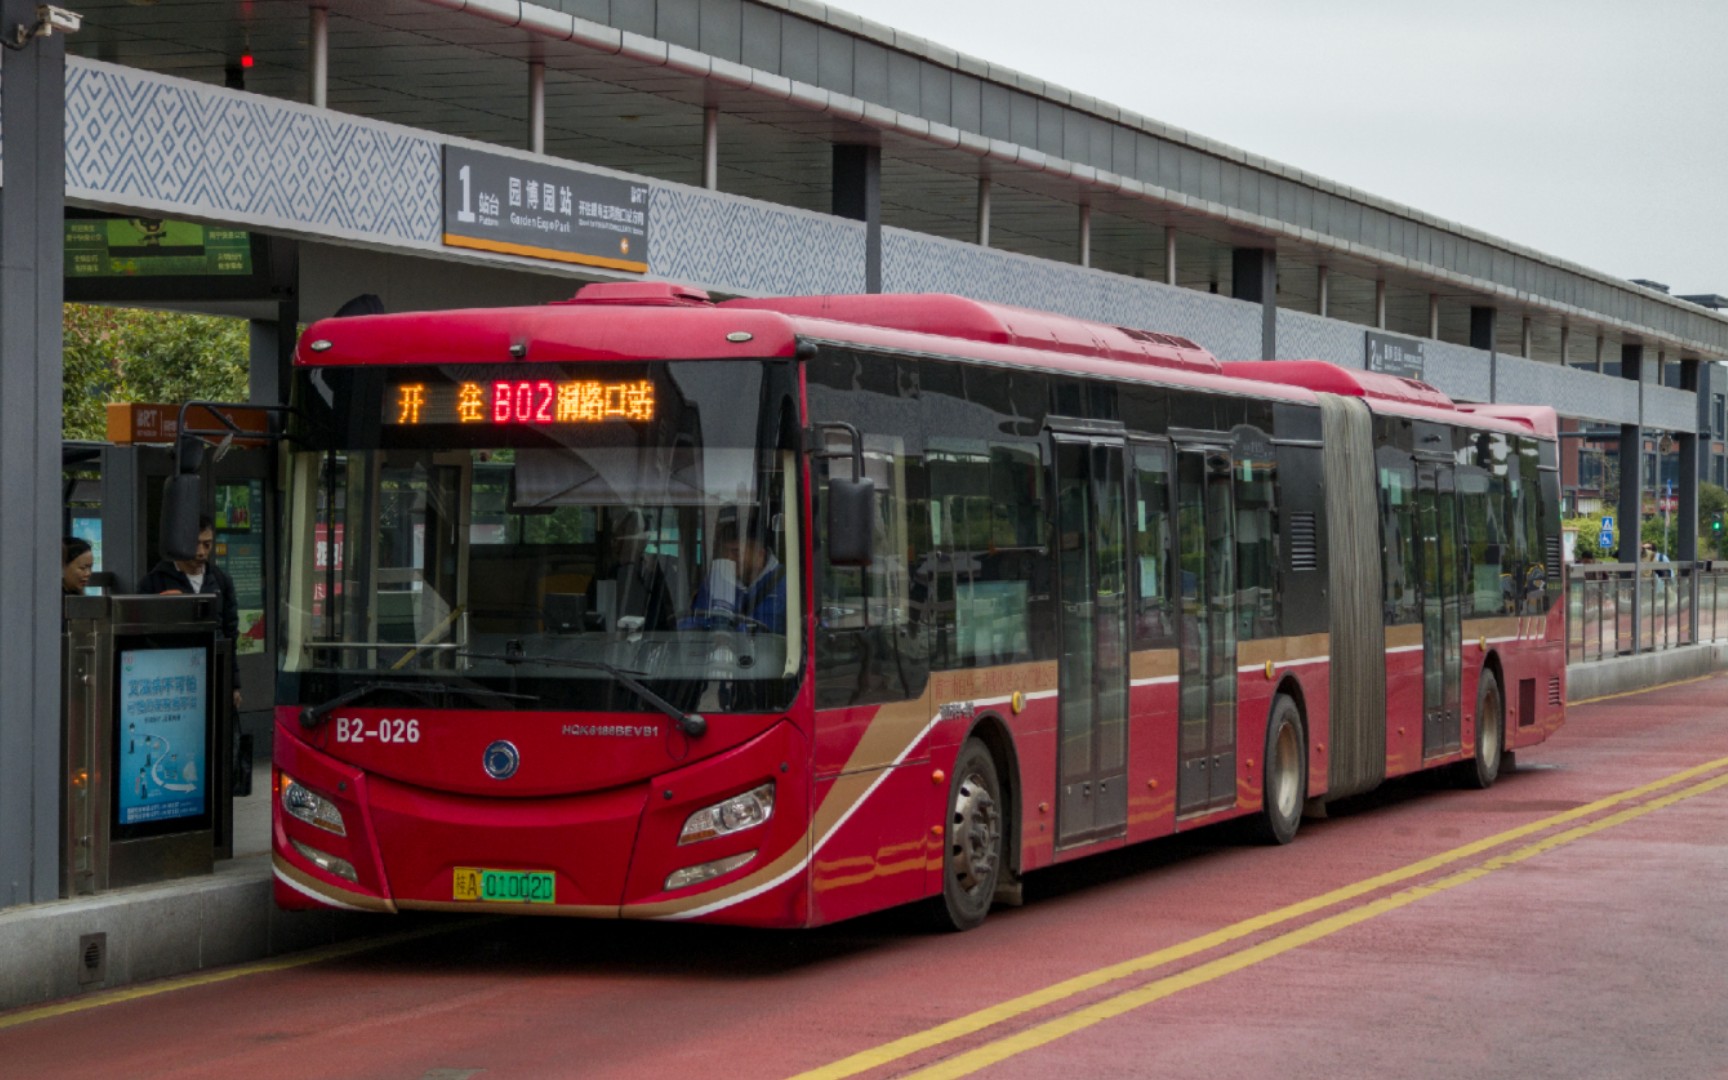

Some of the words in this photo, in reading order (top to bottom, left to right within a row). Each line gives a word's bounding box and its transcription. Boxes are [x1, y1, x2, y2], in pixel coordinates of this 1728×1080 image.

[457, 165, 475, 223] 1
[479, 192, 499, 216] 站台
[509, 176, 572, 216] 园博园站
[510, 212, 537, 227] Garden
[537, 216, 554, 232] Expo
[554, 219, 570, 232] Park
[495, 382, 553, 422] B02
[337, 717, 420, 743] B2-026
